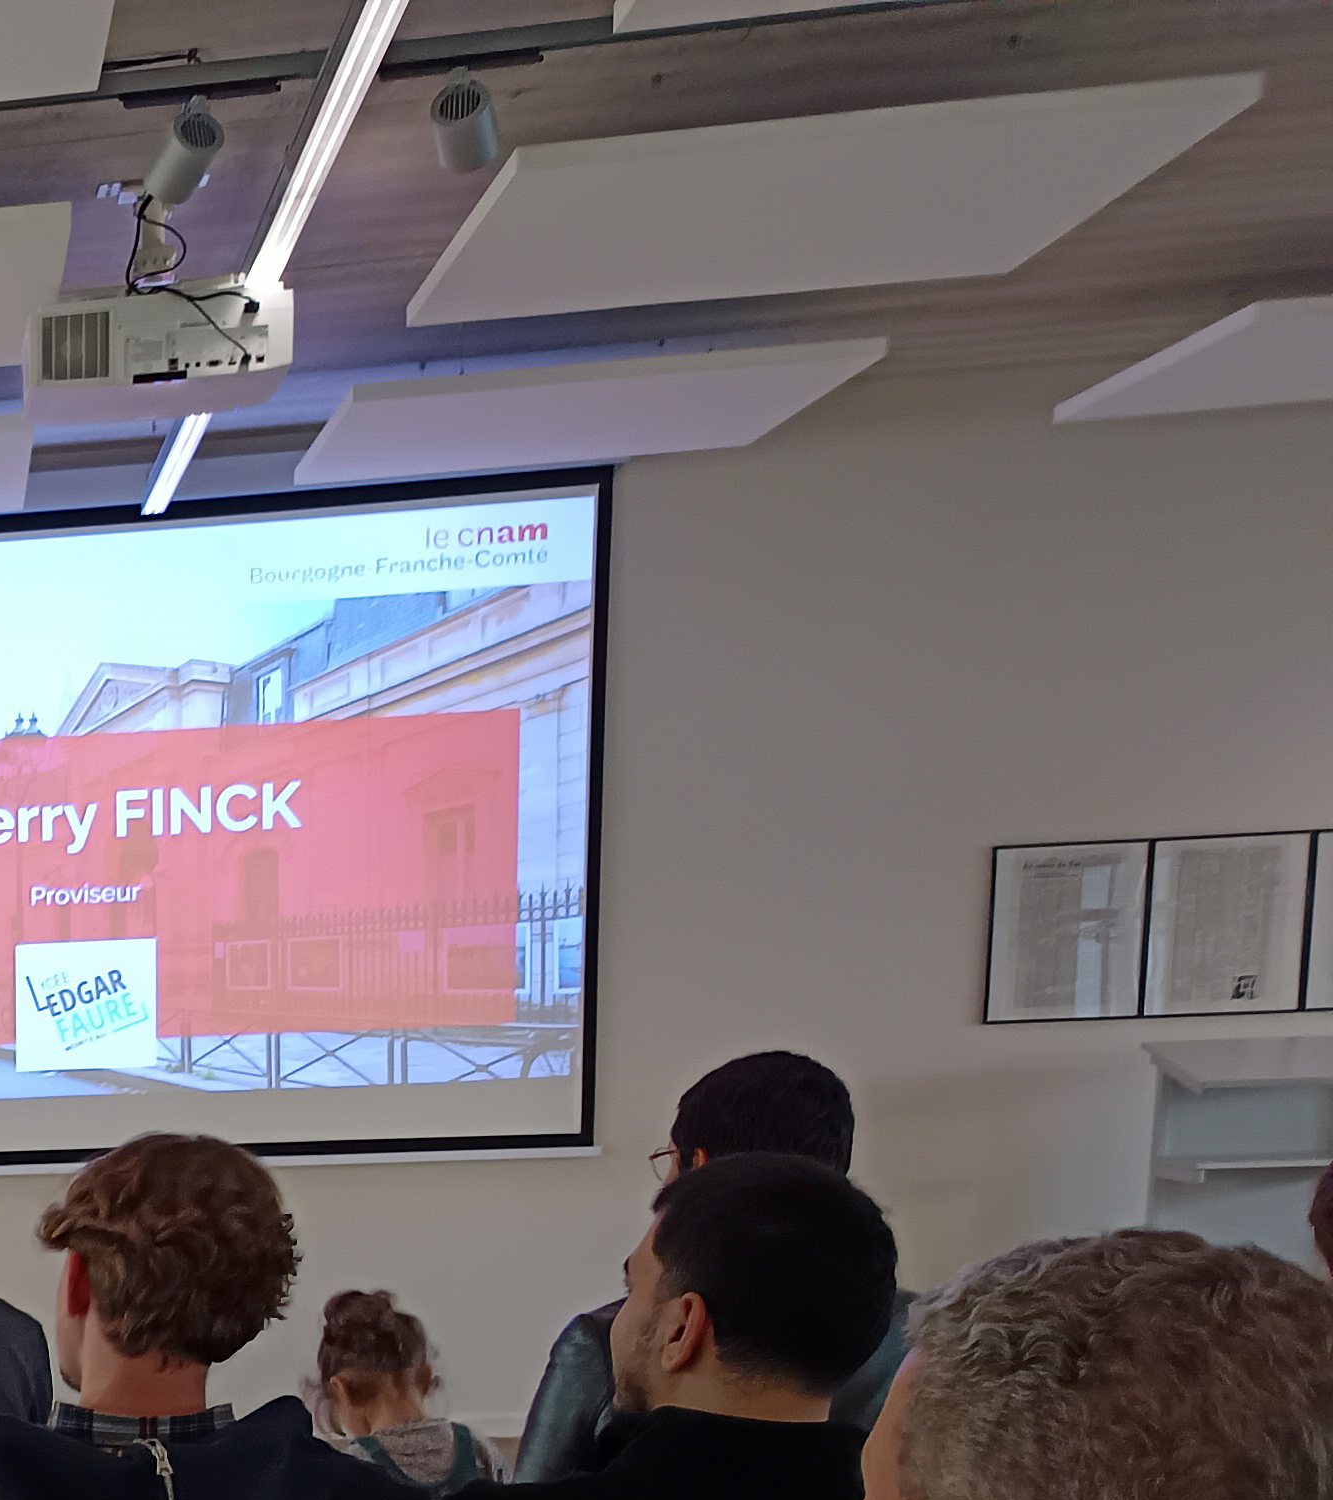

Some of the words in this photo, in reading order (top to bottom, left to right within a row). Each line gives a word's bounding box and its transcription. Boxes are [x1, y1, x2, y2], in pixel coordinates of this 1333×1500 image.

[426, 527, 449, 549] le
[458, 522, 548, 546] cnam
[115, 779, 302, 838] FINCK
[30, 882, 141, 907] Proviseur
[45, 969, 127, 1017] EDGAR
[55, 993, 138, 1043] FAURE
